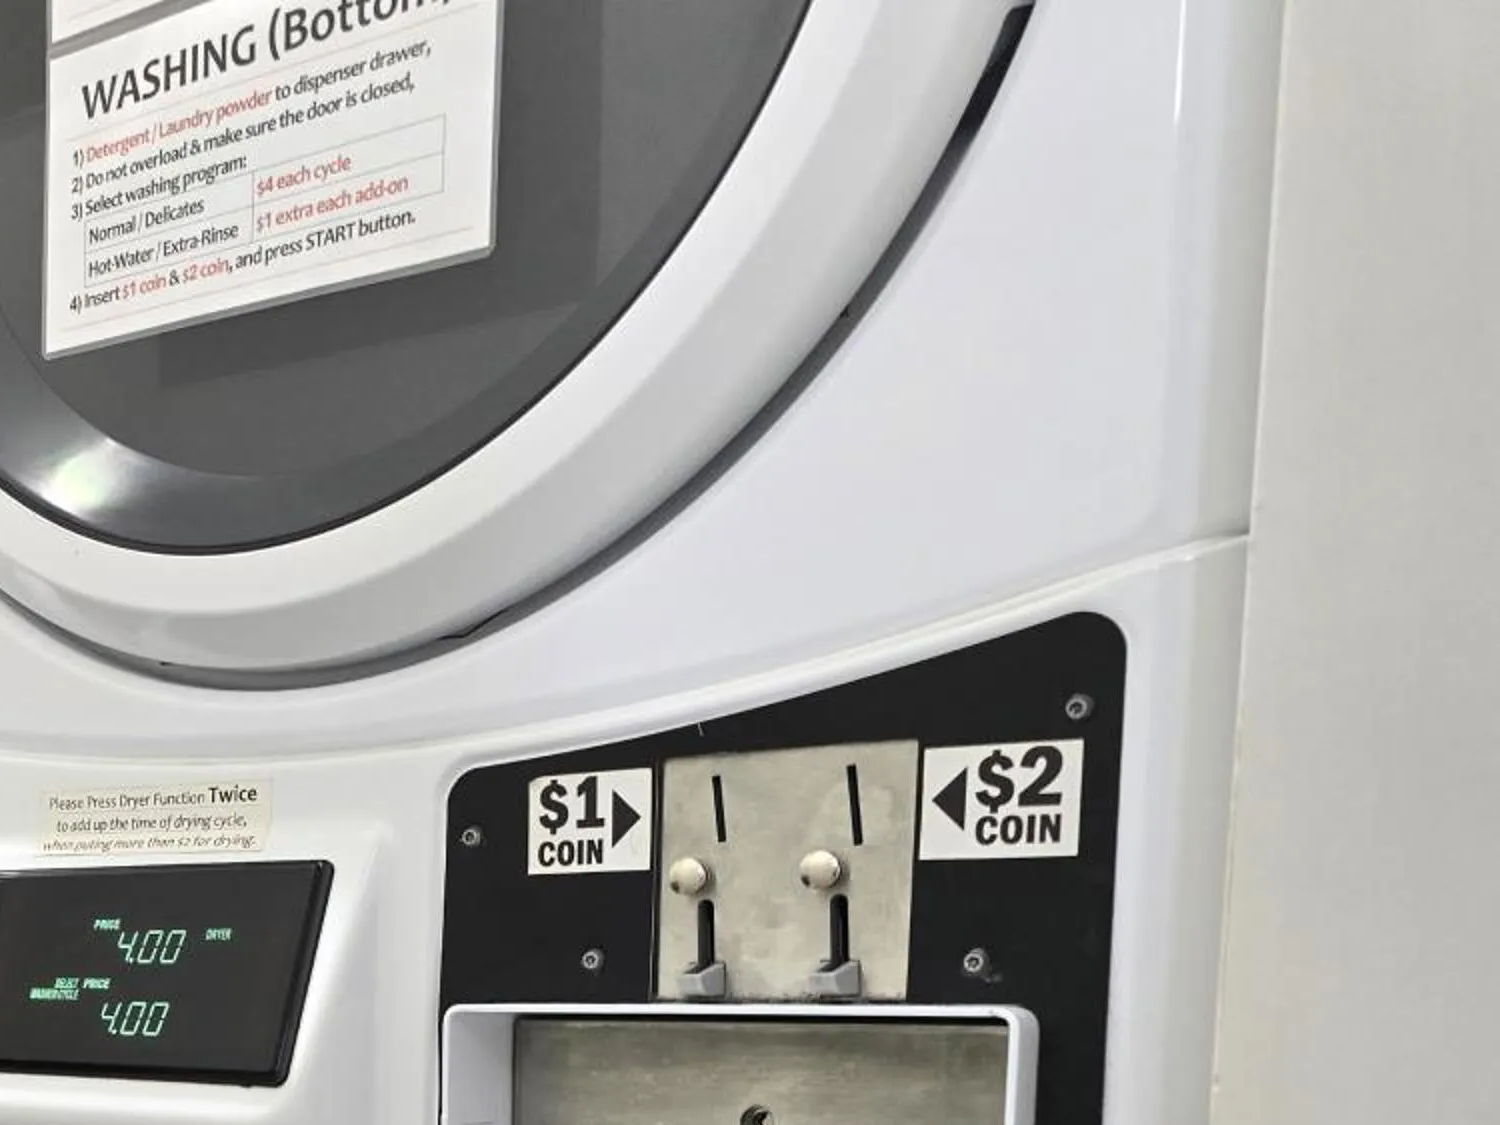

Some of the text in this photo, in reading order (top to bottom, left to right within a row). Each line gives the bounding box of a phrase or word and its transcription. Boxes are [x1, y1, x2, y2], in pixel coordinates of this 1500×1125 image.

[81, 0, 449, 120] WASHING (Botto
[72, 151, 85, 168] 1)
[87, 130, 151, 163] Detergent
[159, 109, 215, 138] Laundry
[215, 91, 272, 124] powder
[275, 84, 291, 101] to
[293, 59, 367, 96] dispenser
[369, 40, 431, 72] drawer,
[71, 71, 415, 195] 2) Do not overload & make sure the door is closed,
[71, 156, 247, 223] 3) Select washing program:
[257, 154, 352, 197] $4 each cycle
[89, 215, 137, 245] Normal
[145, 199, 206, 229] Delicates
[275, 204, 315, 225] extra
[316, 191, 352, 214] each
[355, 176, 409, 204] add-on
[69, 209, 416, 313] 4) Insert $1 coin & $2 coin, and press START button.
[88, 248, 155, 278] Hot-Water
[163, 224, 239, 257] Extra-Rinse
[49, 784, 258, 812] Please Press Dryer Function Twice
[975, 745, 1064, 815] $2
[57, 819, 69, 833] to
[70, 817, 92, 832] add
[93, 819, 108, 836] up
[110, 815, 130, 832] the
[131, 814, 157, 831] time
[159, 813, 171, 833] of
[173, 812, 212, 833] drying
[538, 776, 606, 836] $1
[975, 813, 1062, 846] COIN
[537, 839, 605, 867] COIN
[117, 929, 187, 964] 4.00
[101, 1001, 170, 1036] 4.00
